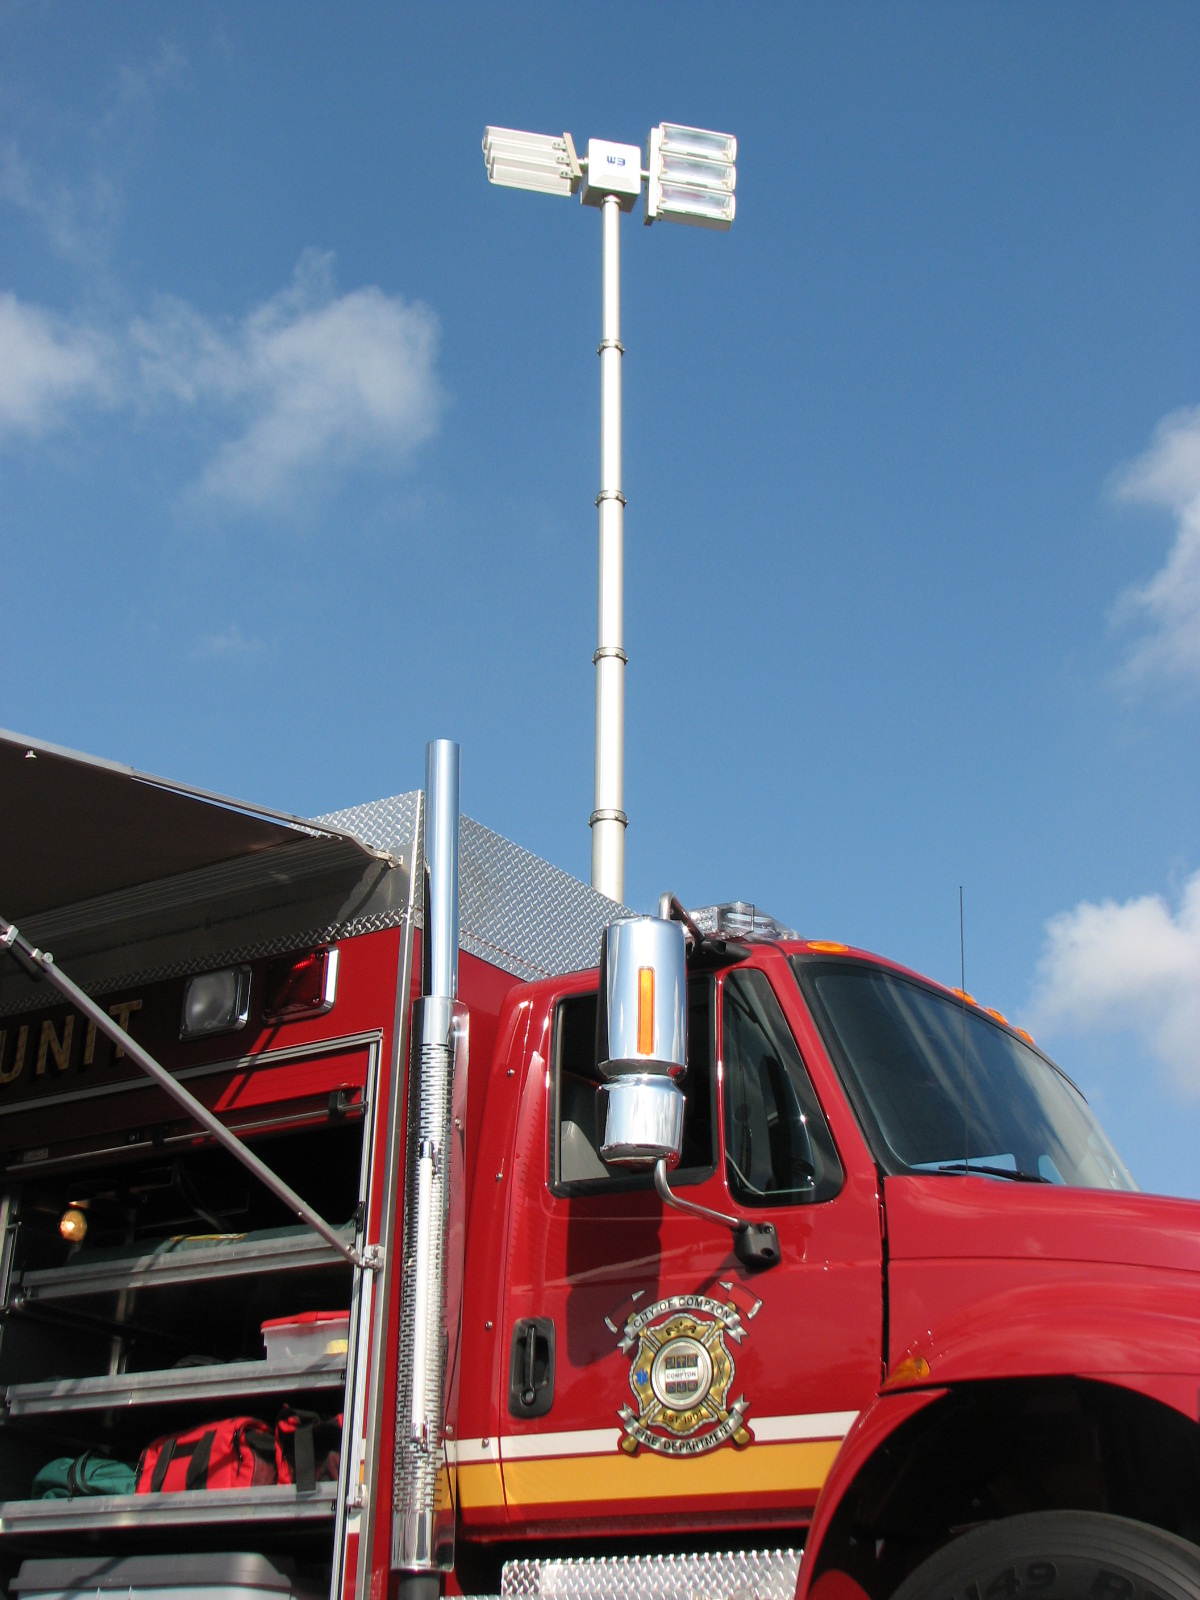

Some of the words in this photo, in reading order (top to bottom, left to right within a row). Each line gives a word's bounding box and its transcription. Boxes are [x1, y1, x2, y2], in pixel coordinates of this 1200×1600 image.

[0, 999, 143, 1084] UNIT
[633, 1307, 655, 1328] CITY
[659, 1298, 674, 1312] OF
[678, 1296, 731, 1320] COMPTON
[666, 1370, 697, 1379] COMPTON
[634, 1427, 658, 1447] FIRE
[663, 1422, 733, 1453] DEPARTMENT
